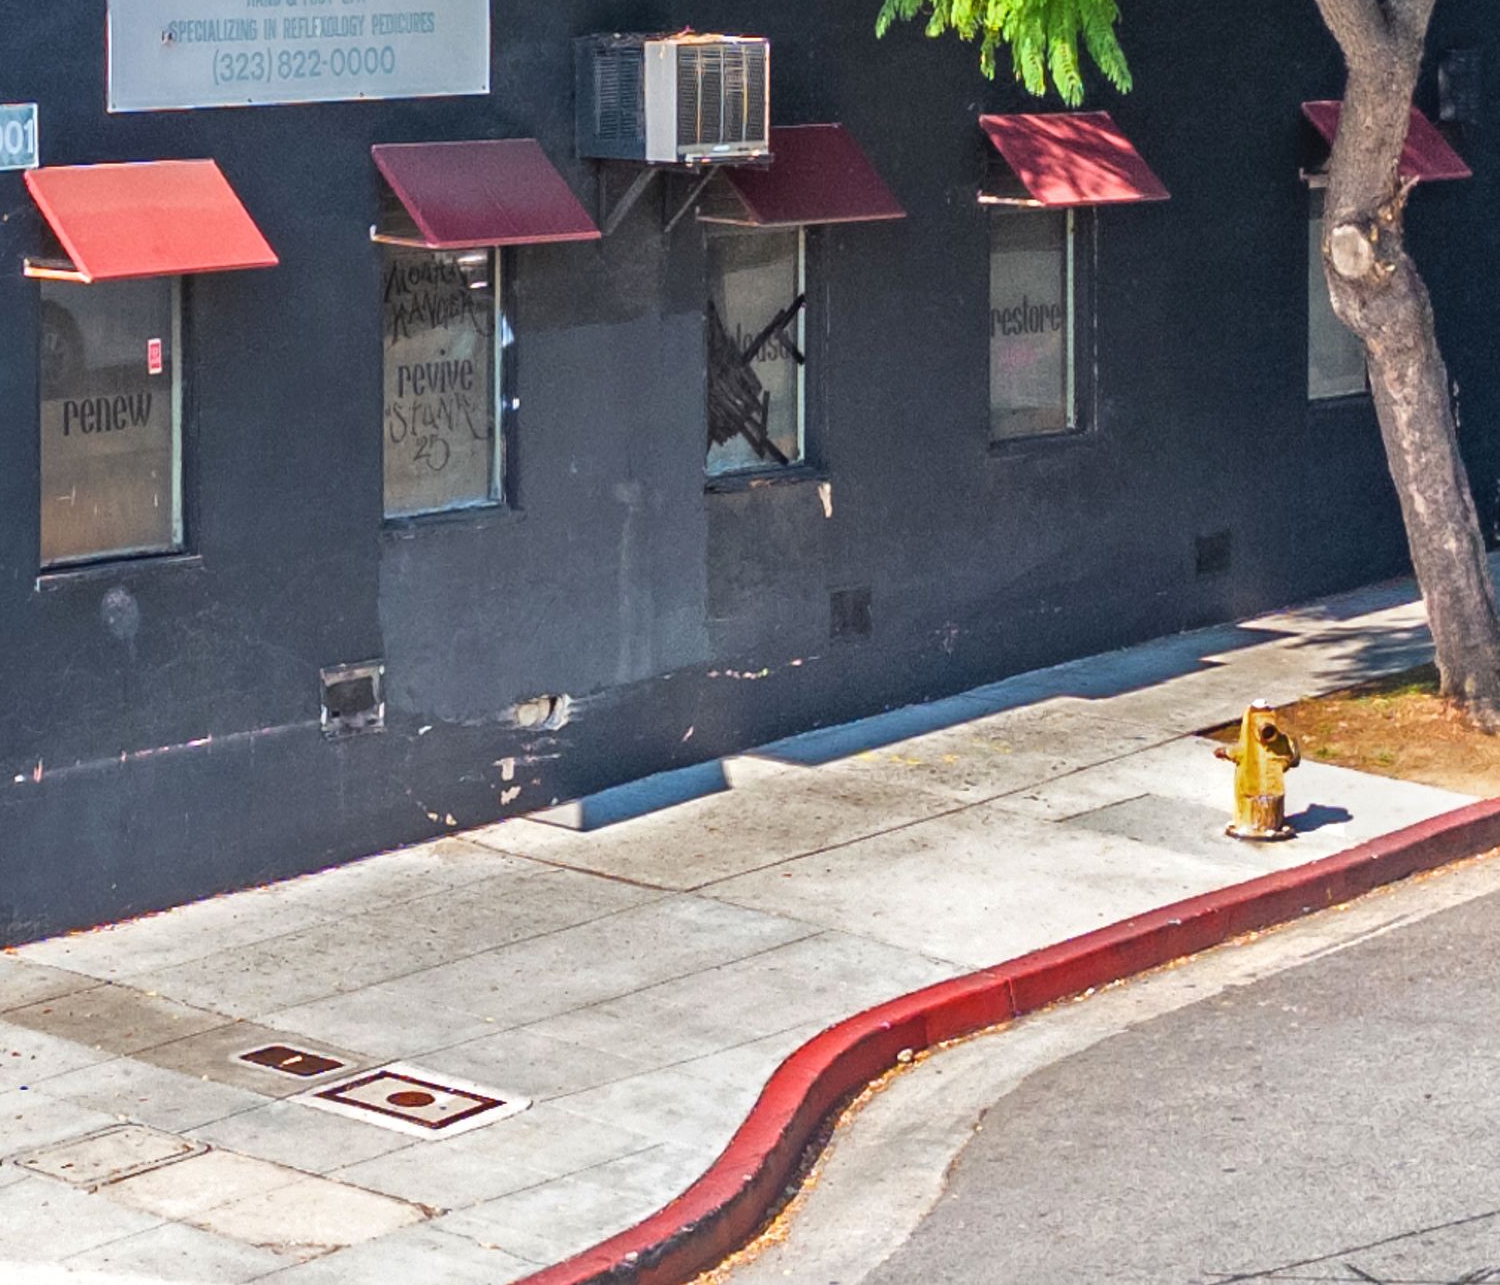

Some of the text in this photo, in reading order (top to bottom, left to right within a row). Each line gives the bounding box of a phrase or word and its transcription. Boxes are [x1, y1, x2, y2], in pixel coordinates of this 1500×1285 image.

[168, 17, 258, 43] SPECIALIZING
[263, 17, 278, 41] IN
[371, 11, 435, 36] PEDICURES
[212, 45, 396, 86] (323) 822-0000
[990, 294, 1061, 338] restore
[397, 349, 474, 399] revive
[62, 391, 153, 437] renew
